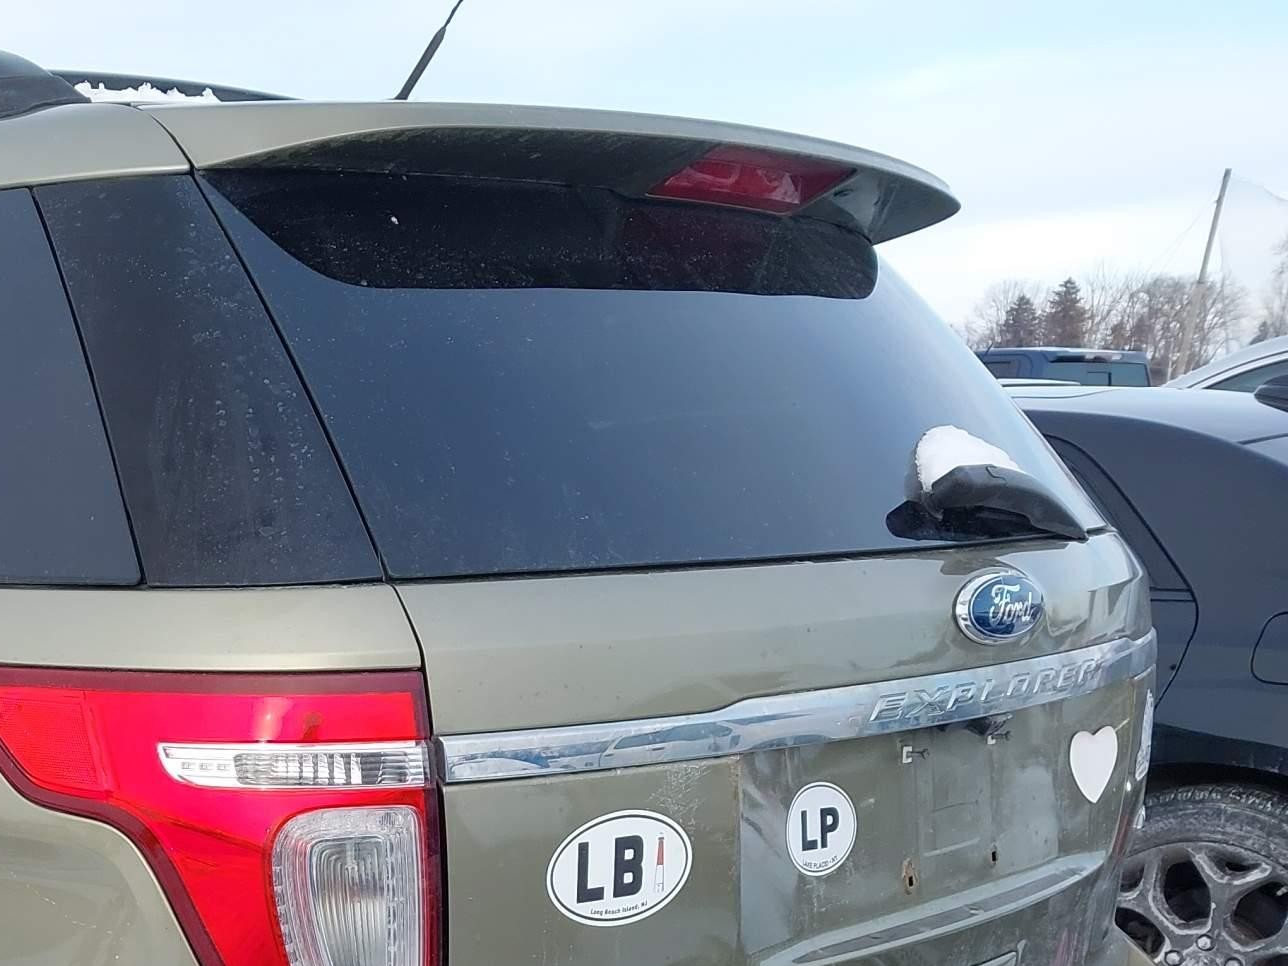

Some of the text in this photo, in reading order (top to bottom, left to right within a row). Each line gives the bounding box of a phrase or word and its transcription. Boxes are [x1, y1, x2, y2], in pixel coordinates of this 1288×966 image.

[989, 583, 1032, 627] Ford
[868, 657, 1106, 722] EXPLORER
[800, 806, 840, 852] LP
[590, 907, 604, 917] Long
